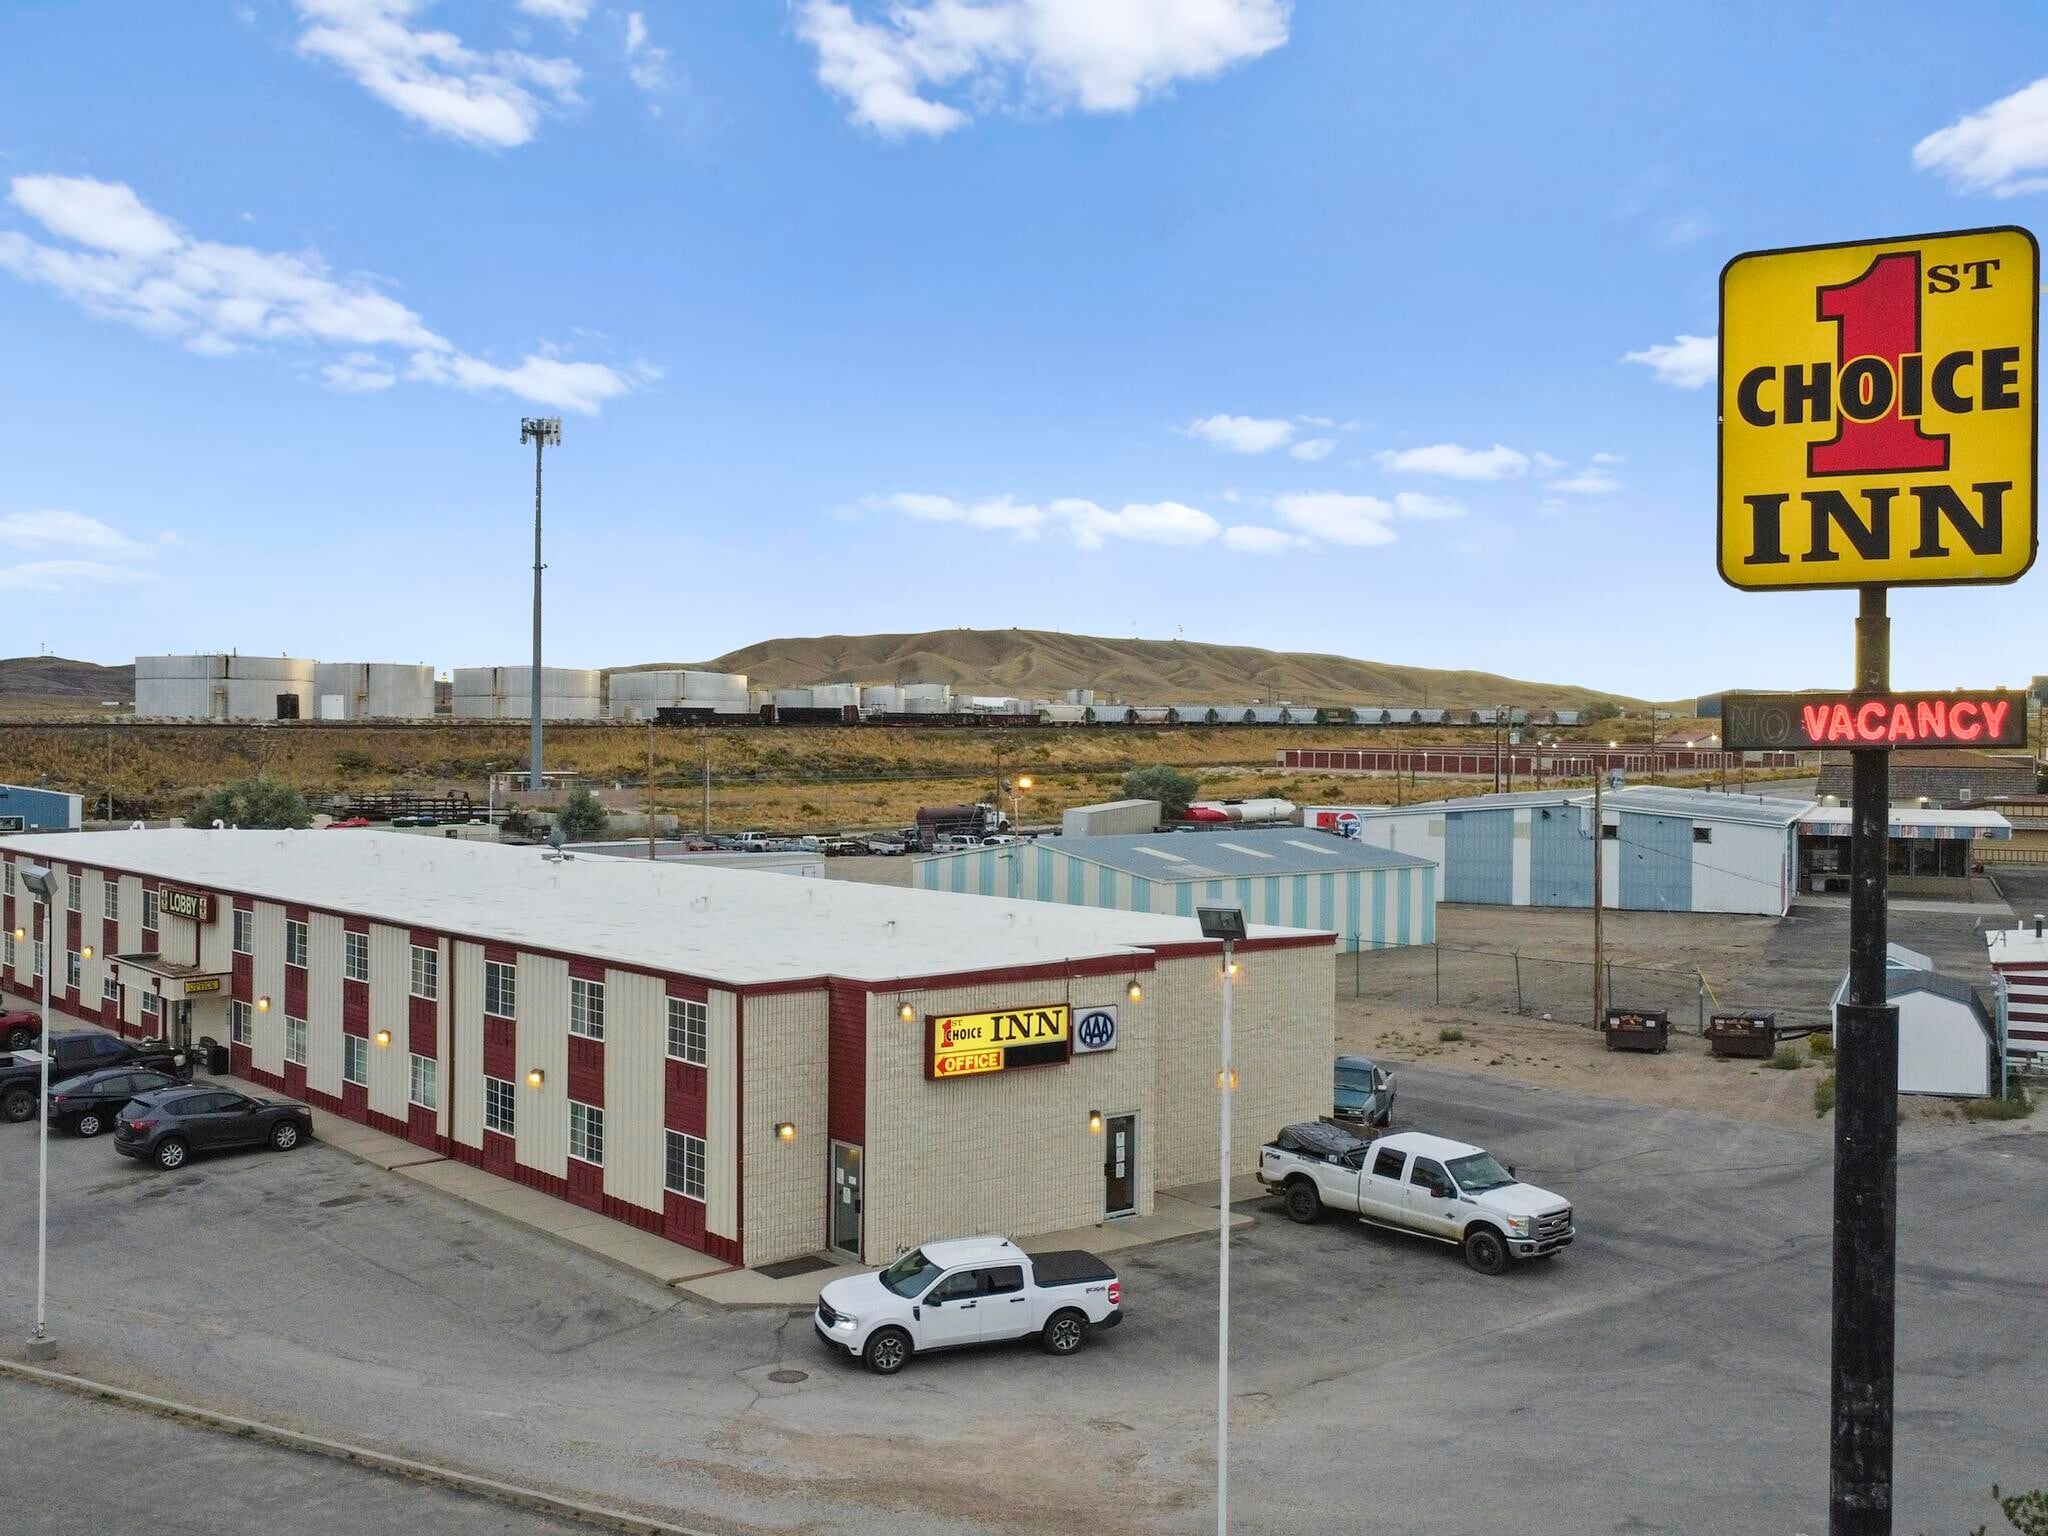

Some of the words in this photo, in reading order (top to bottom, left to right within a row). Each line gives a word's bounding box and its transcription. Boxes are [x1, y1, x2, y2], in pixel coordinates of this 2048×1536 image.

[1737, 346, 2020, 427] CHOICE
[1743, 481, 2012, 565] INN
[1730, 704, 1790, 744] NO
[1803, 700, 2008, 741] VACANCY
[169, 892, 197, 916] LOBBY
[946, 1027, 982, 1042] CHOICE
[990, 1010, 1062, 1042] INN
[1083, 1016, 1109, 1044] AAA
[944, 1054, 998, 1072] OFFICE
